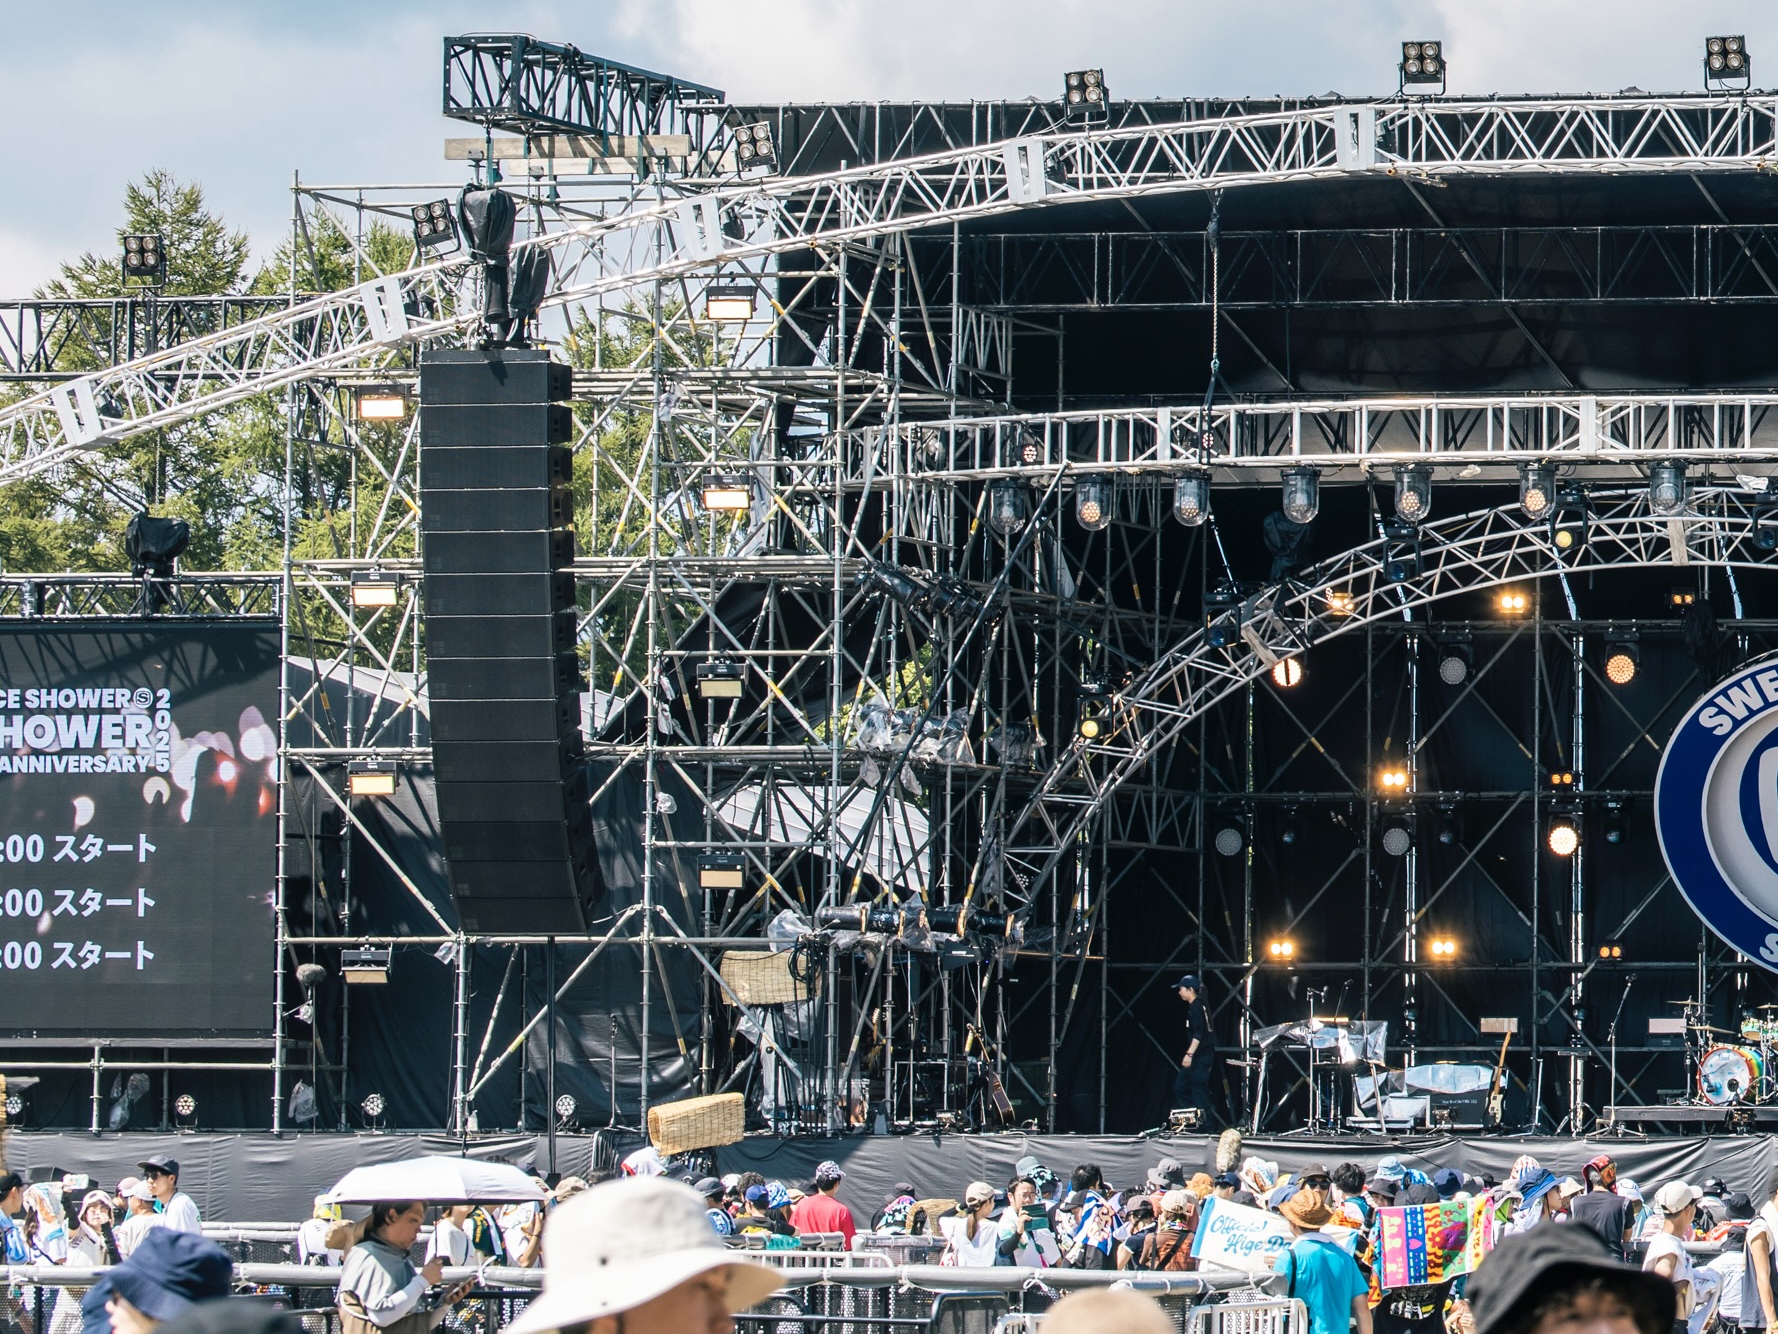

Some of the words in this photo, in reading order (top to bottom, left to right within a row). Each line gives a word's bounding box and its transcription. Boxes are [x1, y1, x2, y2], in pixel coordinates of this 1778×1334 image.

[24, 688, 131, 709] SHOWER
[0, 755, 151, 774] ANNIVERSARY
[52, 833, 157, 863] スタート
[51, 887, 156, 918] スタート
[51, 940, 155, 970] スタート
[1223, 1233, 1263, 1257] Hige
